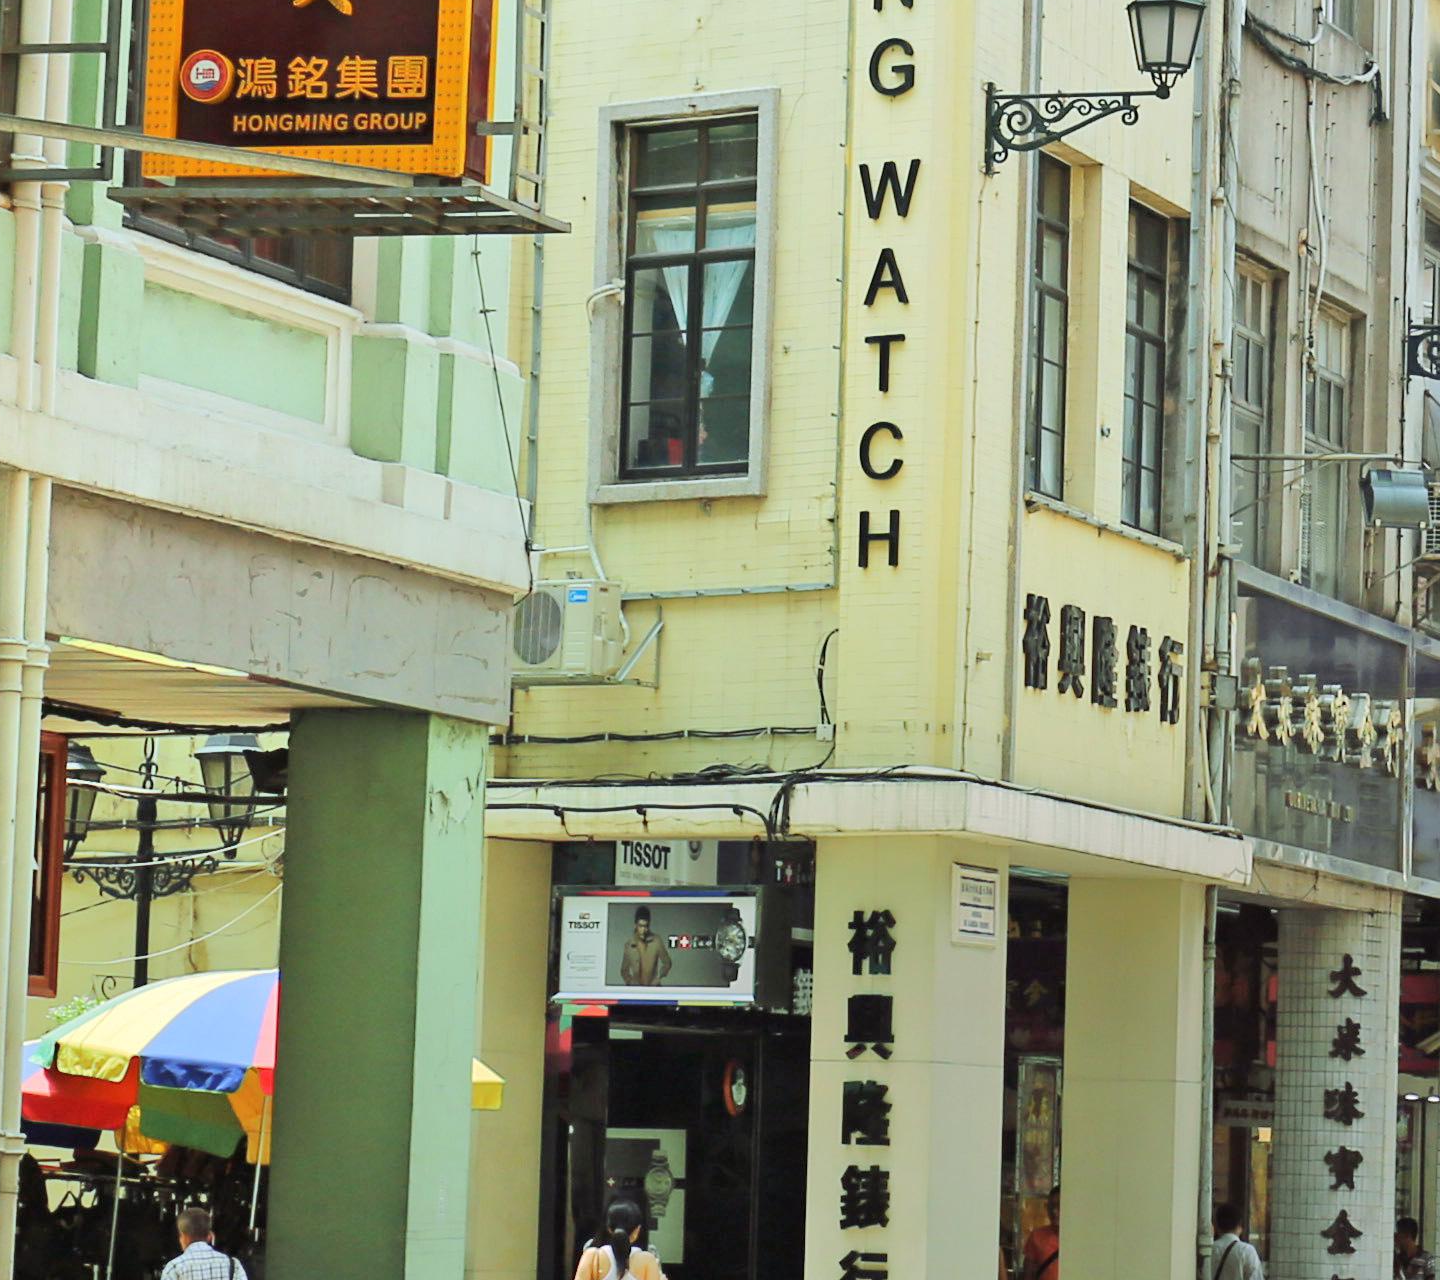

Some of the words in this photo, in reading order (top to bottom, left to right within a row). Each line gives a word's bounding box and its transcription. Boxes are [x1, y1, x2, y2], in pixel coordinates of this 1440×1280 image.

[235, 55, 428, 100] 鴻銘集團
[233, 114, 348, 132] HONGMING
[353, 112, 427, 130] GROUP
[858, 158, 921, 570] WATCH
[621, 840, 671, 871] TISSOT
[568, 920, 601, 930] TISSOT
